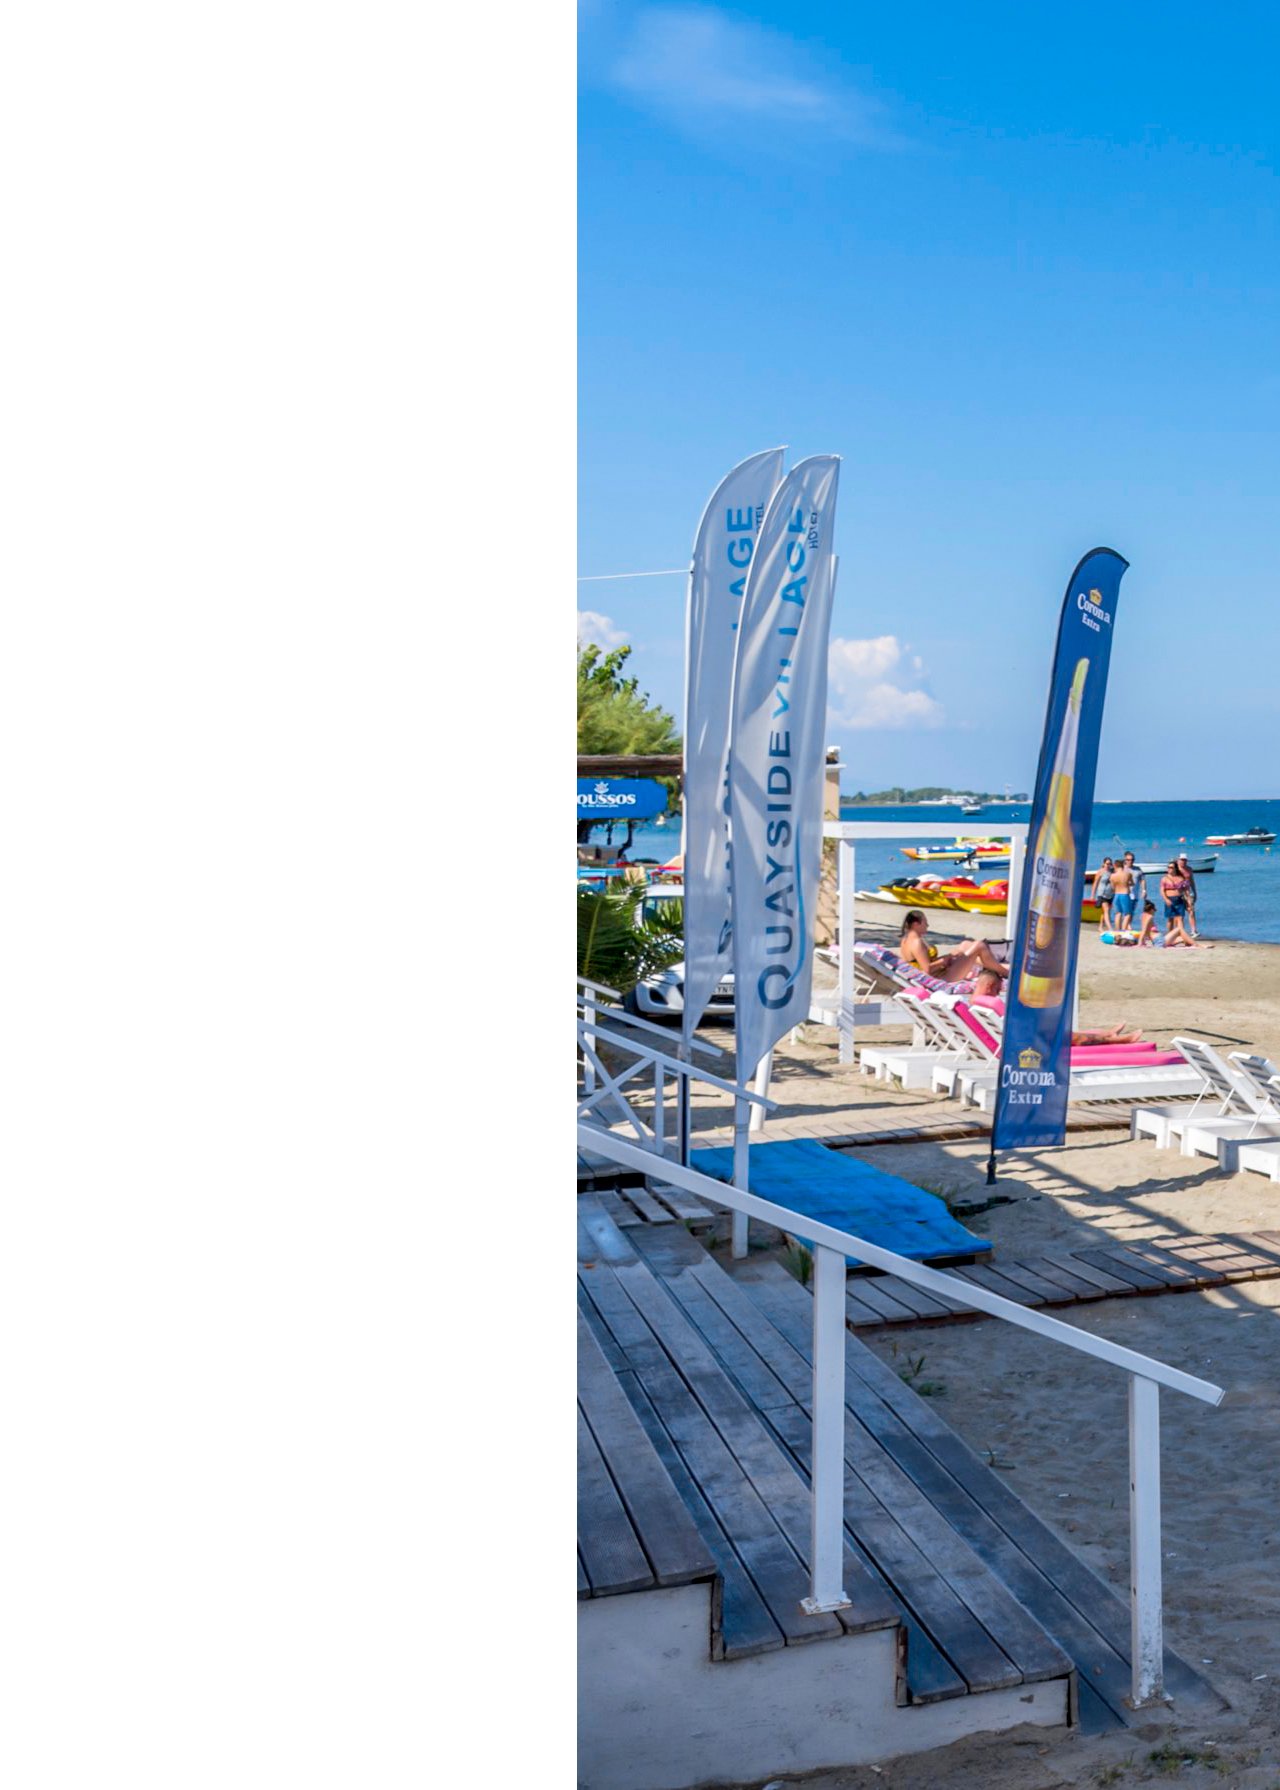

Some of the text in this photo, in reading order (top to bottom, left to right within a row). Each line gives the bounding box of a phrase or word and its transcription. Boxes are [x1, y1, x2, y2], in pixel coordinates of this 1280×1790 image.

[1077, 593, 1111, 624] Corona
[757, 730, 797, 1010] QUAYSIDE
[1036, 857, 1070, 880] Corona
[1001, 1064, 1056, 1088] Corona
